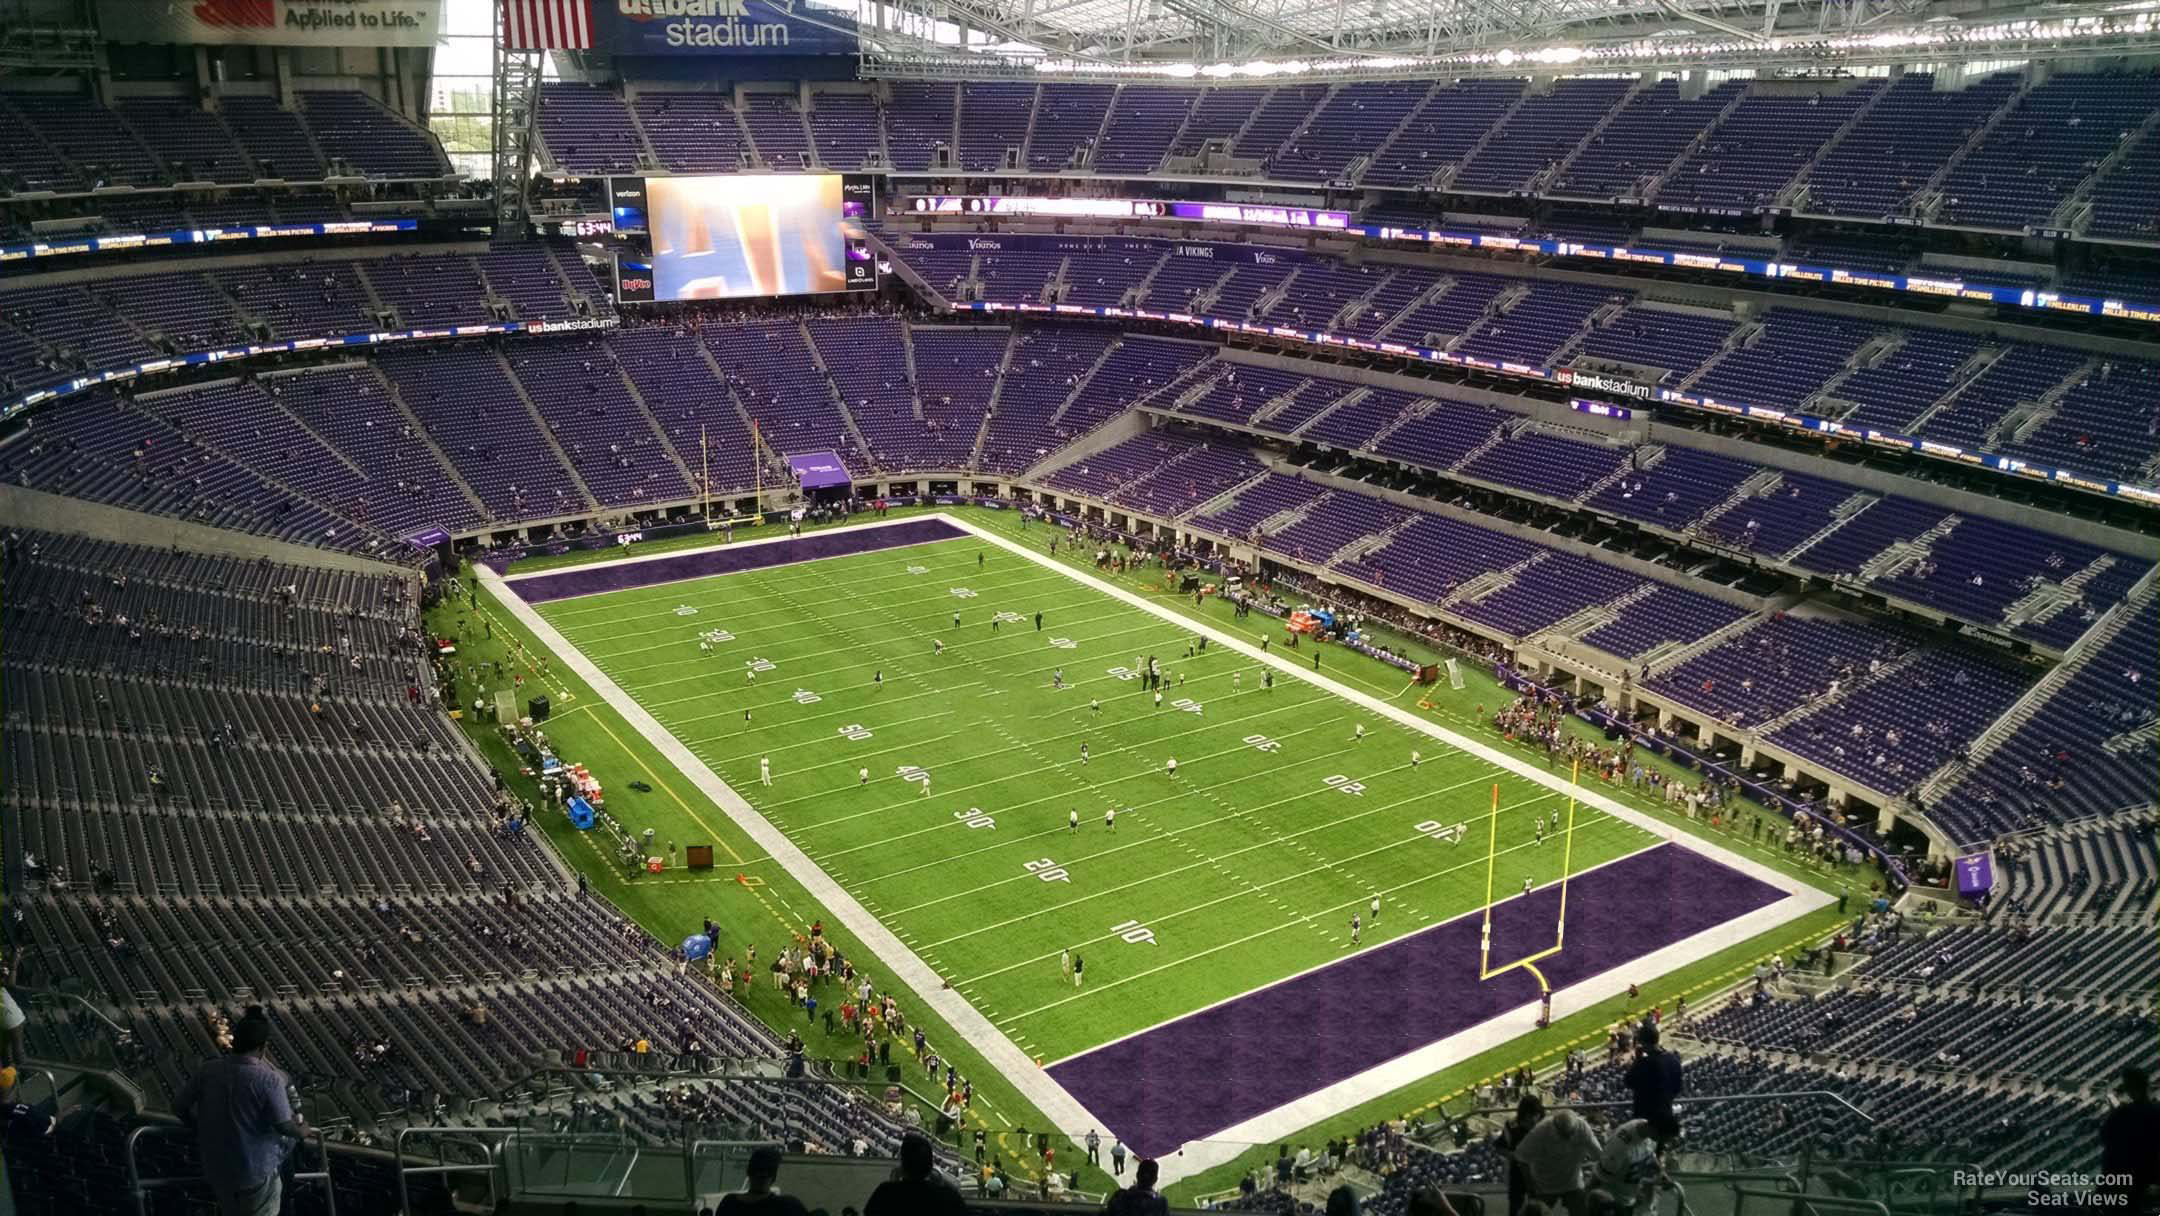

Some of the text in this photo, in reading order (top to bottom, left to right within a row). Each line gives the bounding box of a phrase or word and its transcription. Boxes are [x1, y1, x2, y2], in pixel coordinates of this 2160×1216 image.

[286, 8, 356, 31] Applied
[360, 12, 378, 26] to
[666, 18, 789, 47] stadium
[615, 190, 640, 198] verizon
[577, 222, 612, 236] 63:44
[1185, 246, 1213, 258] VIKINGS
[838, 723, 873, 741] 50
[896, 766, 931, 782] 40
[1322, 774, 1367, 796] 20
[954, 807, 996, 829] 30
[1023, 857, 1071, 883] 20
[1110, 919, 1160, 945] 10
